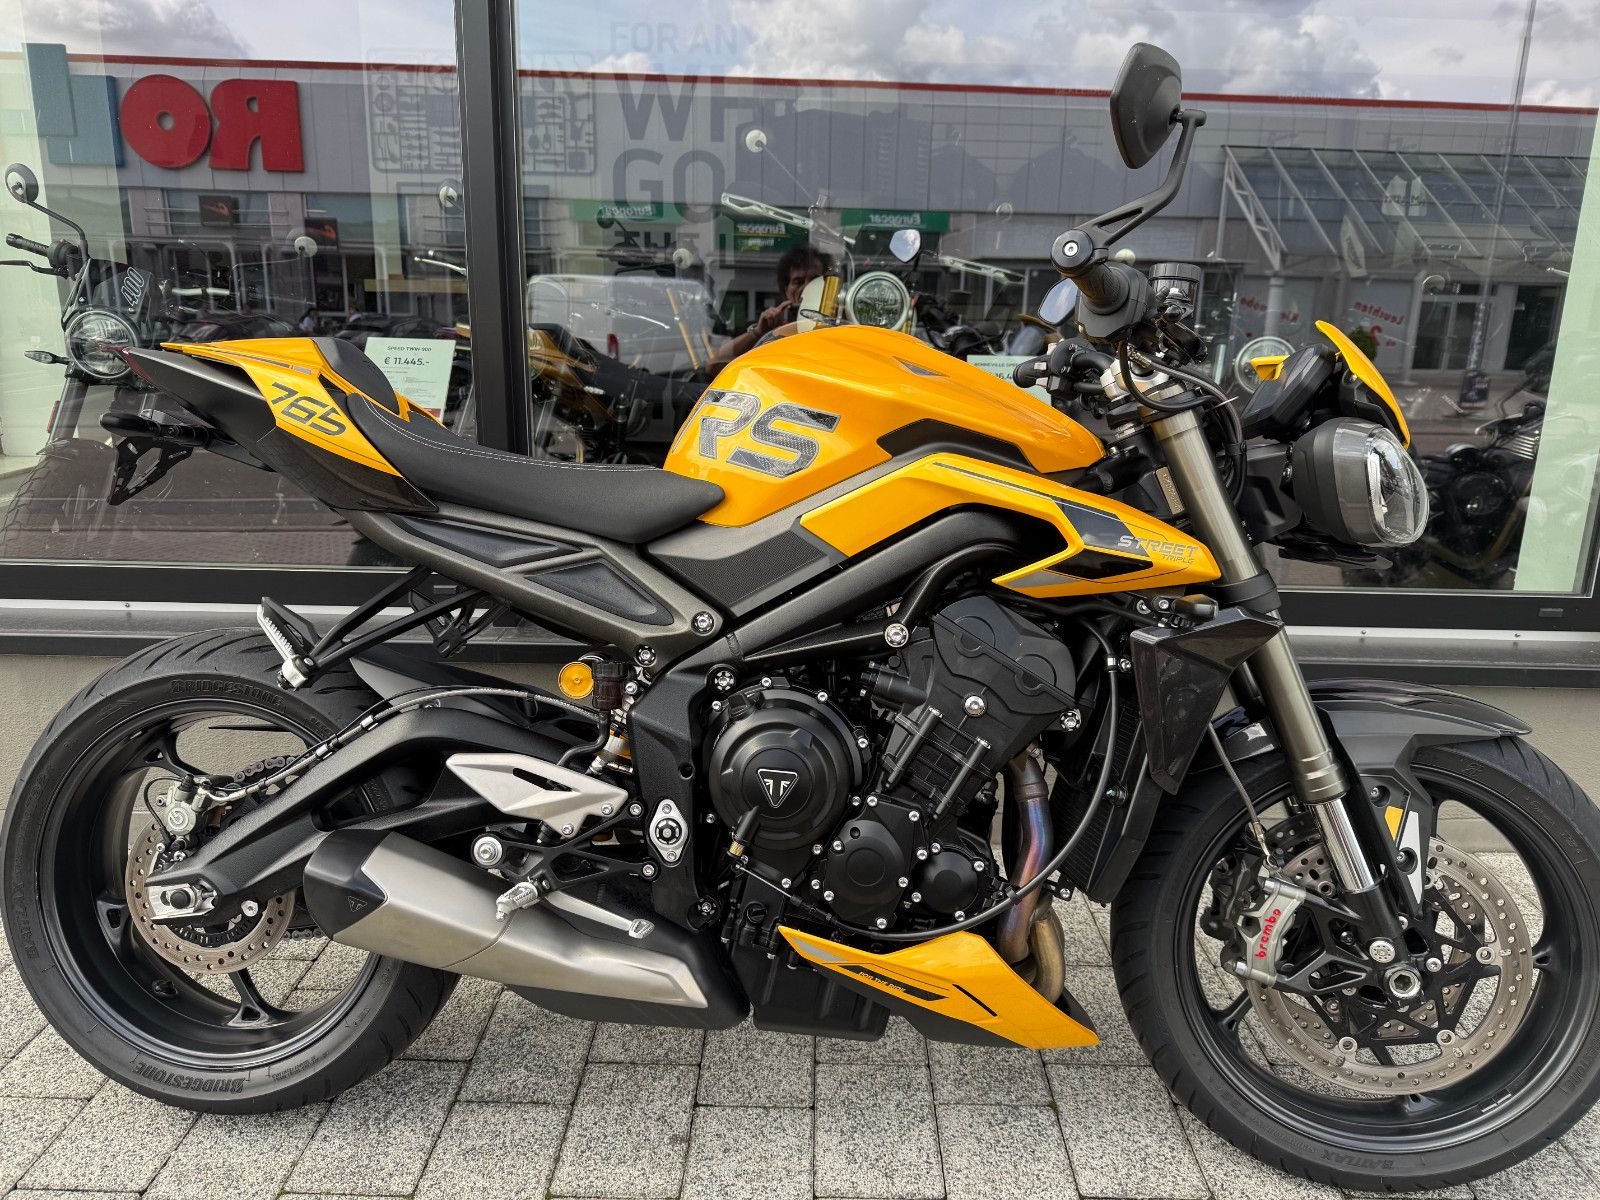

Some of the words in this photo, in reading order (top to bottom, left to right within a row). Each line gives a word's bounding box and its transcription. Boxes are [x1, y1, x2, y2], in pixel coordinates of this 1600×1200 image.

[120, 266, 145, 306] 400
[384, 356, 391, 365] €
[271, 381, 347, 437] 765
[672, 388, 842, 479] RS
[1117, 535, 1199, 558] STREET
[1162, 554, 1195, 565] TRIPLE
[171, 678, 284, 707] BRIDGESTONE
[1254, 908, 1281, 958] brembo
[859, 971, 874, 980] FOR
[874, 977, 889, 986] THE
[888, 983, 907, 992] RIDE
[132, 1062, 246, 1094] BRIDGESTONE
